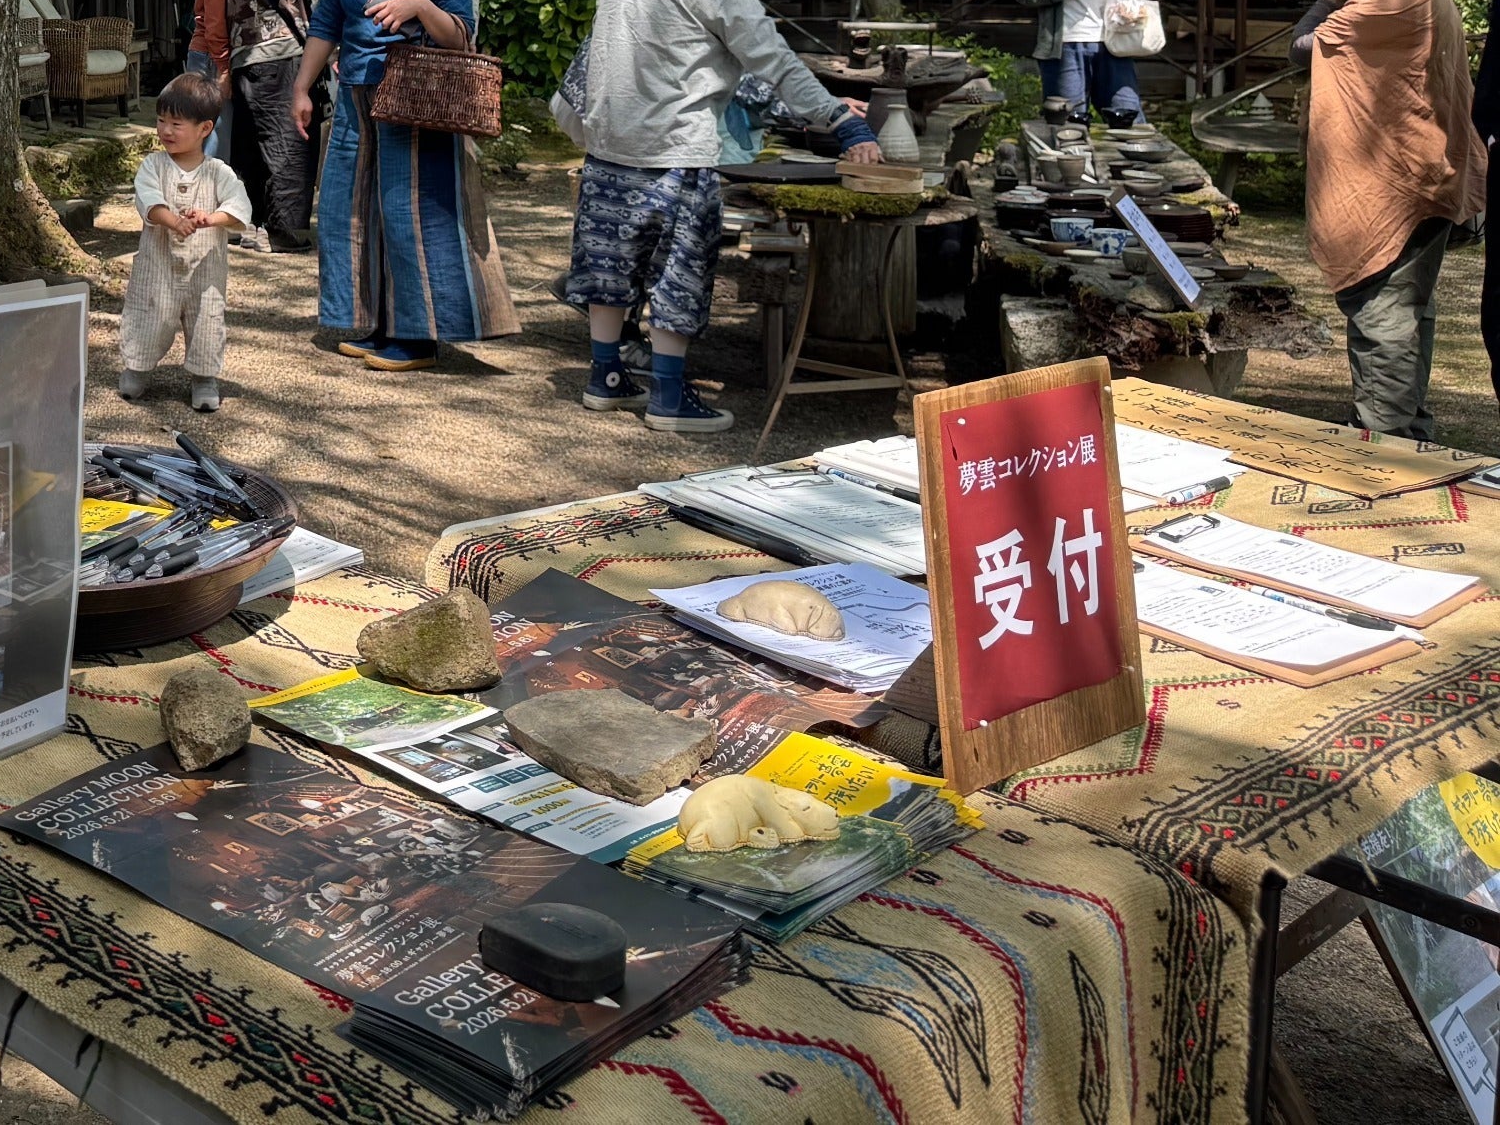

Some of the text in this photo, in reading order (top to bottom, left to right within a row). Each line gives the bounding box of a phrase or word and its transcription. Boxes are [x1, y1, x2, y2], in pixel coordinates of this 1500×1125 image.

[958, 434, 1097, 495] 夢雲コレクション展
[973, 508, 1102, 650] 受付
[14, 761, 160, 822] Gallery MOON
[36, 772, 182, 831] COLLECTION
[335, 913, 442, 981] 夢雲コレクション展
[394, 957, 486, 1006] Gallery
